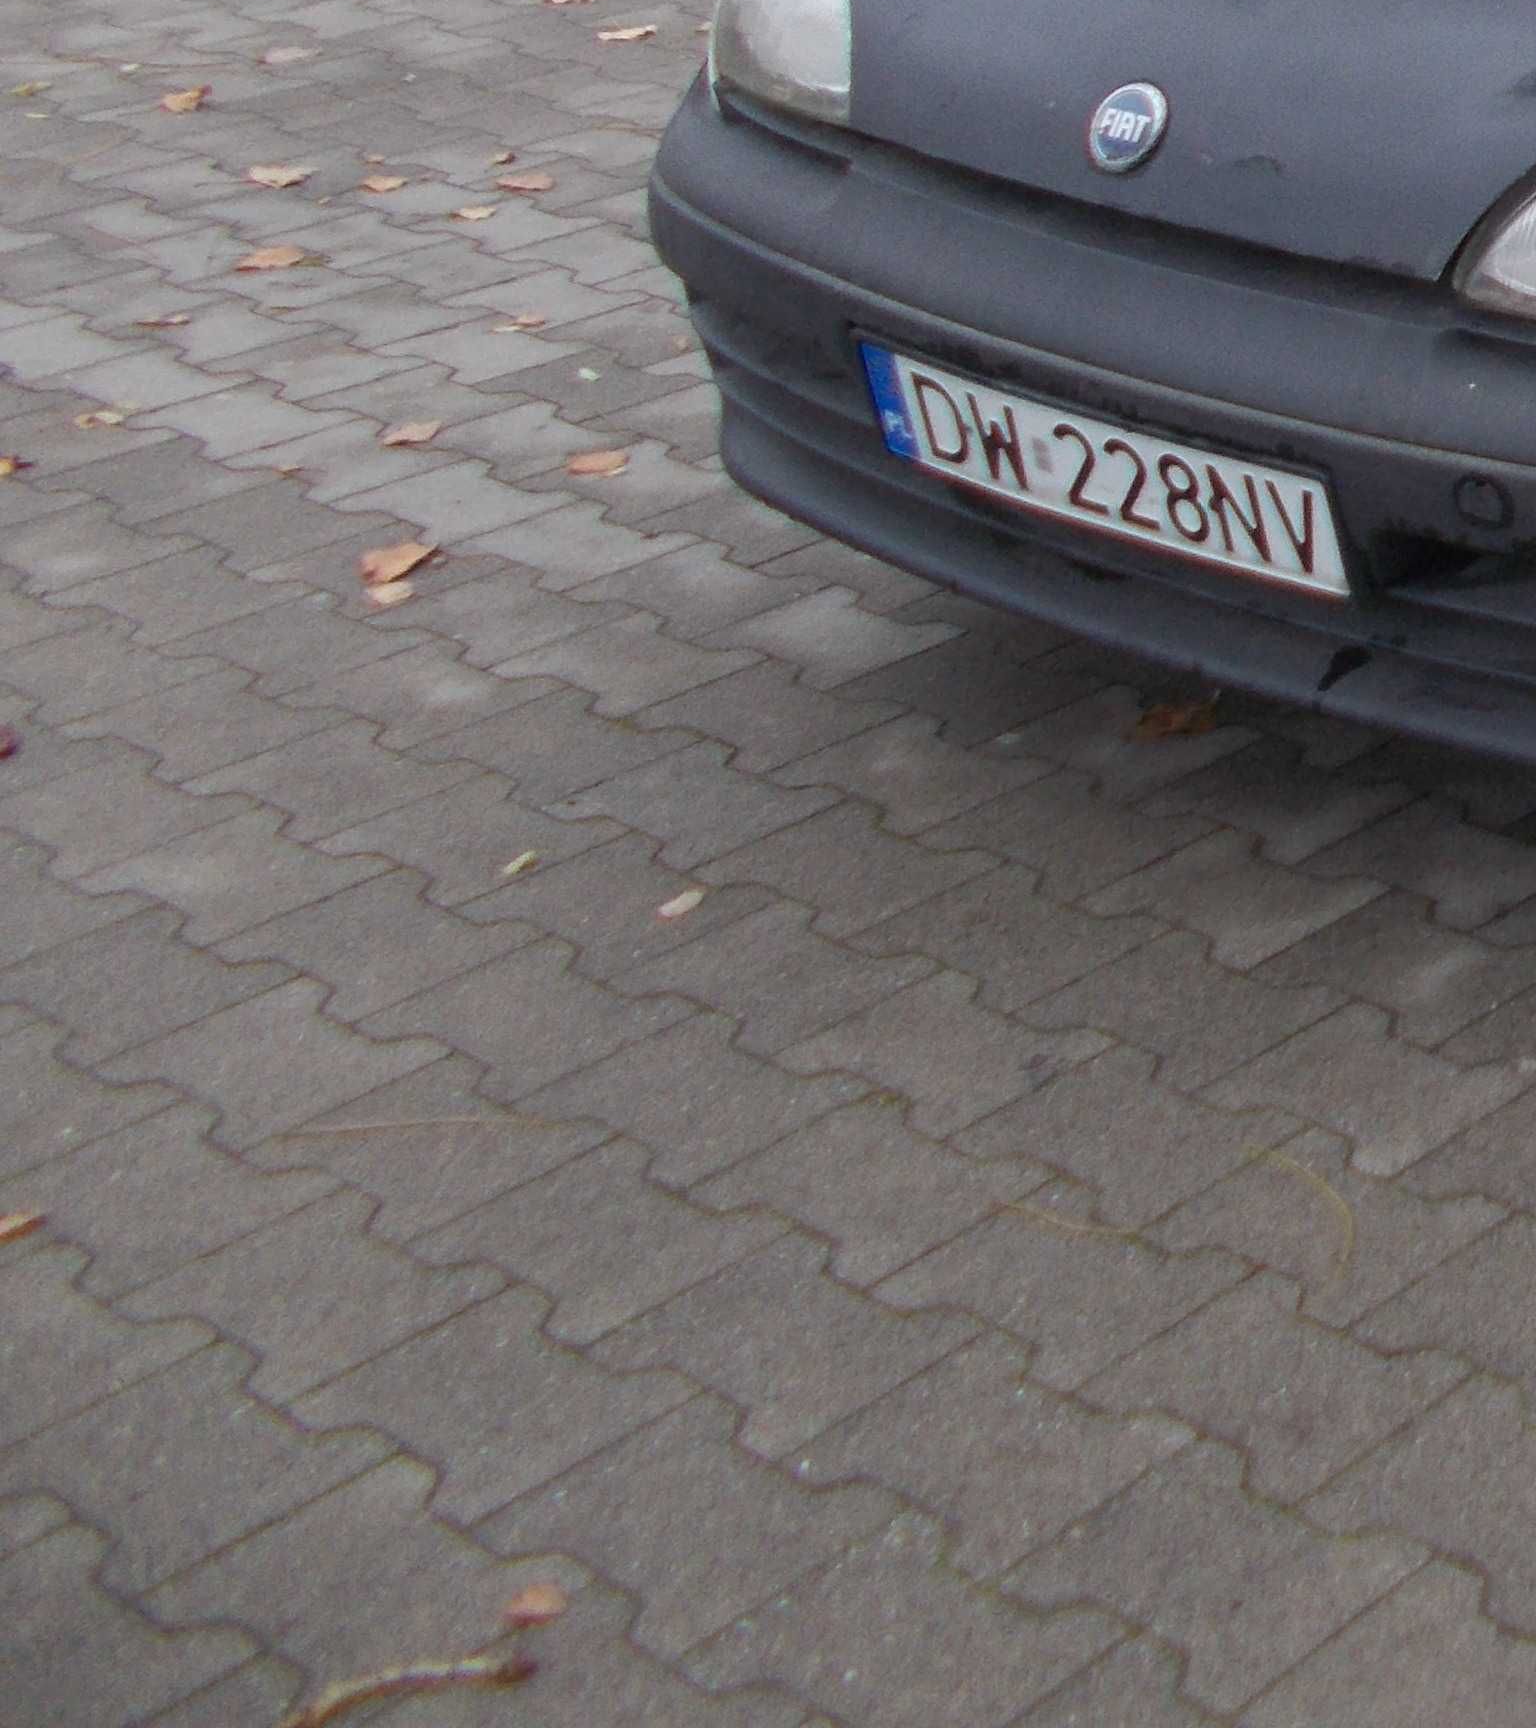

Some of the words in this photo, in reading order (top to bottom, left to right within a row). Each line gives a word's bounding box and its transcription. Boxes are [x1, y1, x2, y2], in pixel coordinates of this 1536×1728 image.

[1099, 108, 1153, 144] FIAT
[910, 371, 1030, 492] DW
[1052, 423, 1315, 573] 228NV
